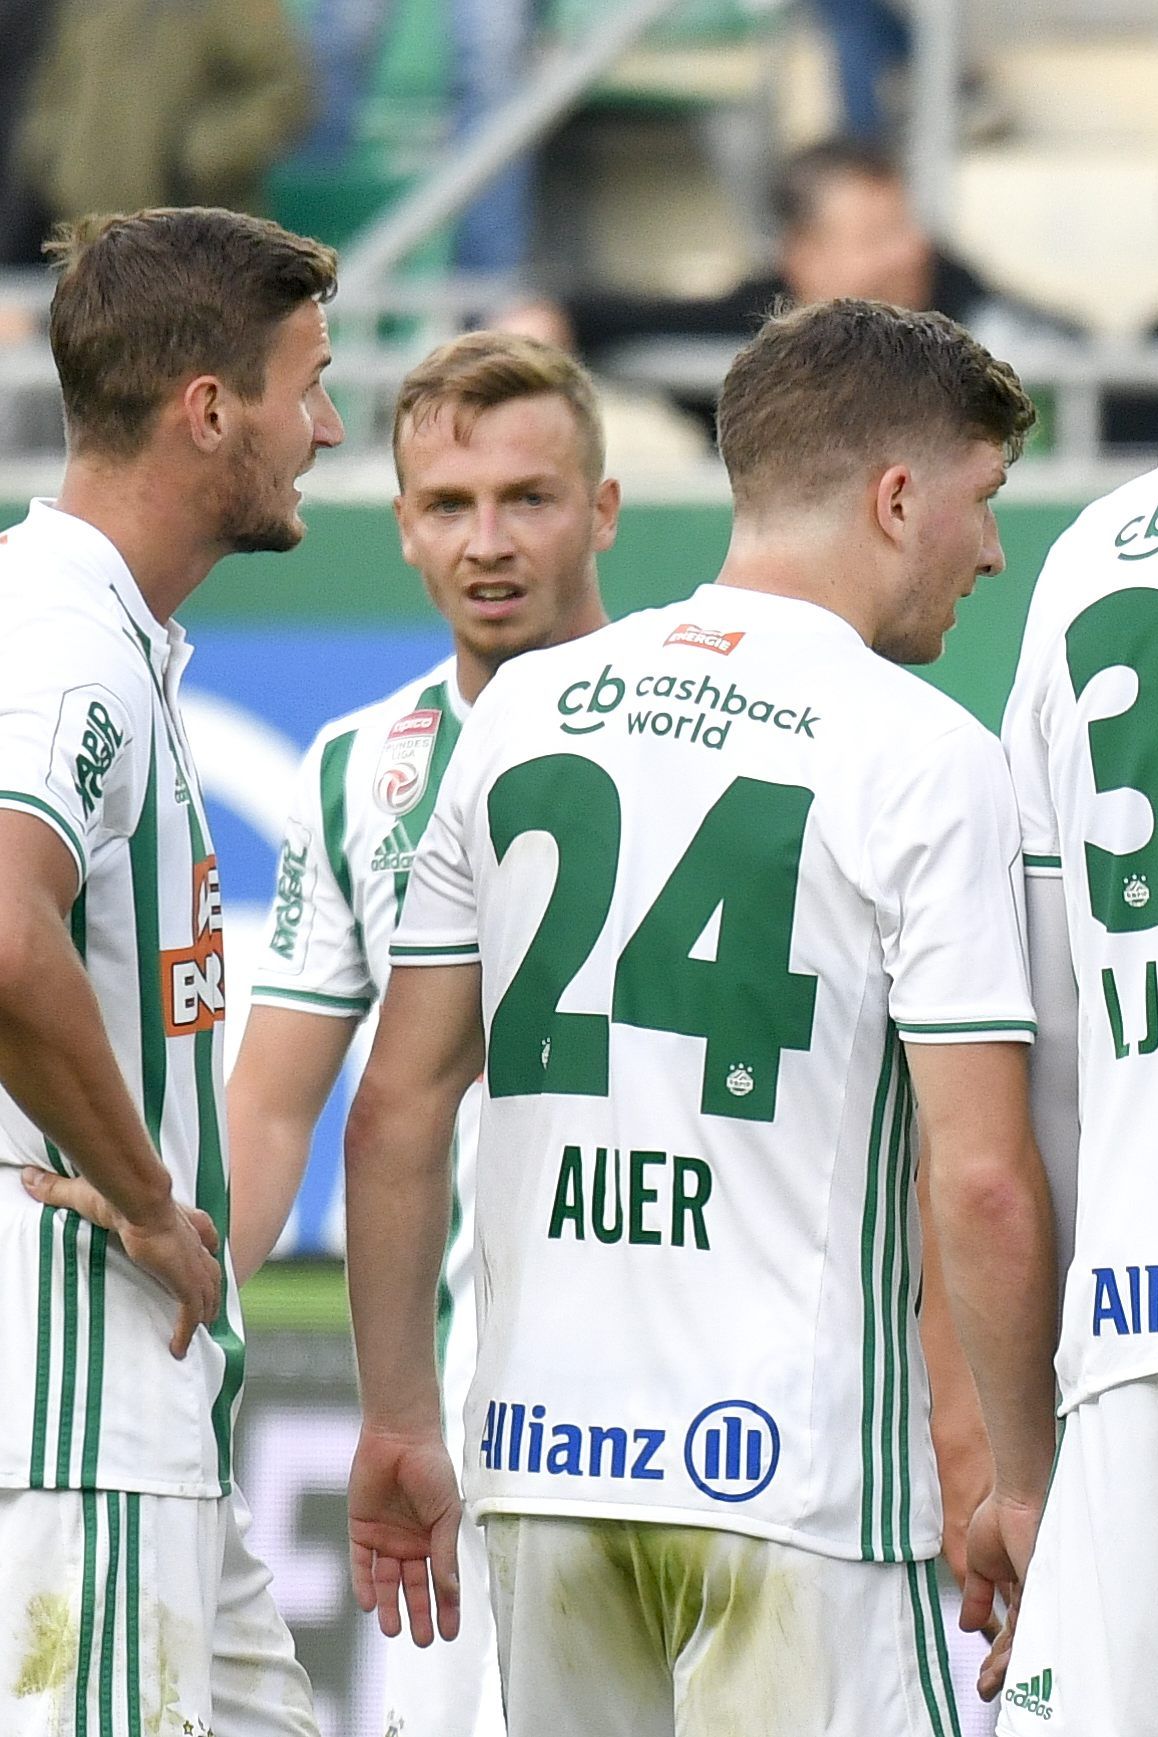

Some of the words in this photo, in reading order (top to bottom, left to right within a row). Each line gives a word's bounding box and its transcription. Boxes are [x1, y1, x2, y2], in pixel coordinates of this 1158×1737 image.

[557, 664, 626, 716] cb
[636, 675, 821, 739] cashback
[627, 711, 732, 750] world
[487, 753, 818, 1122] 24
[548, 1145, 712, 1251] AUER
[1005, 1688, 1053, 1721] adidas
